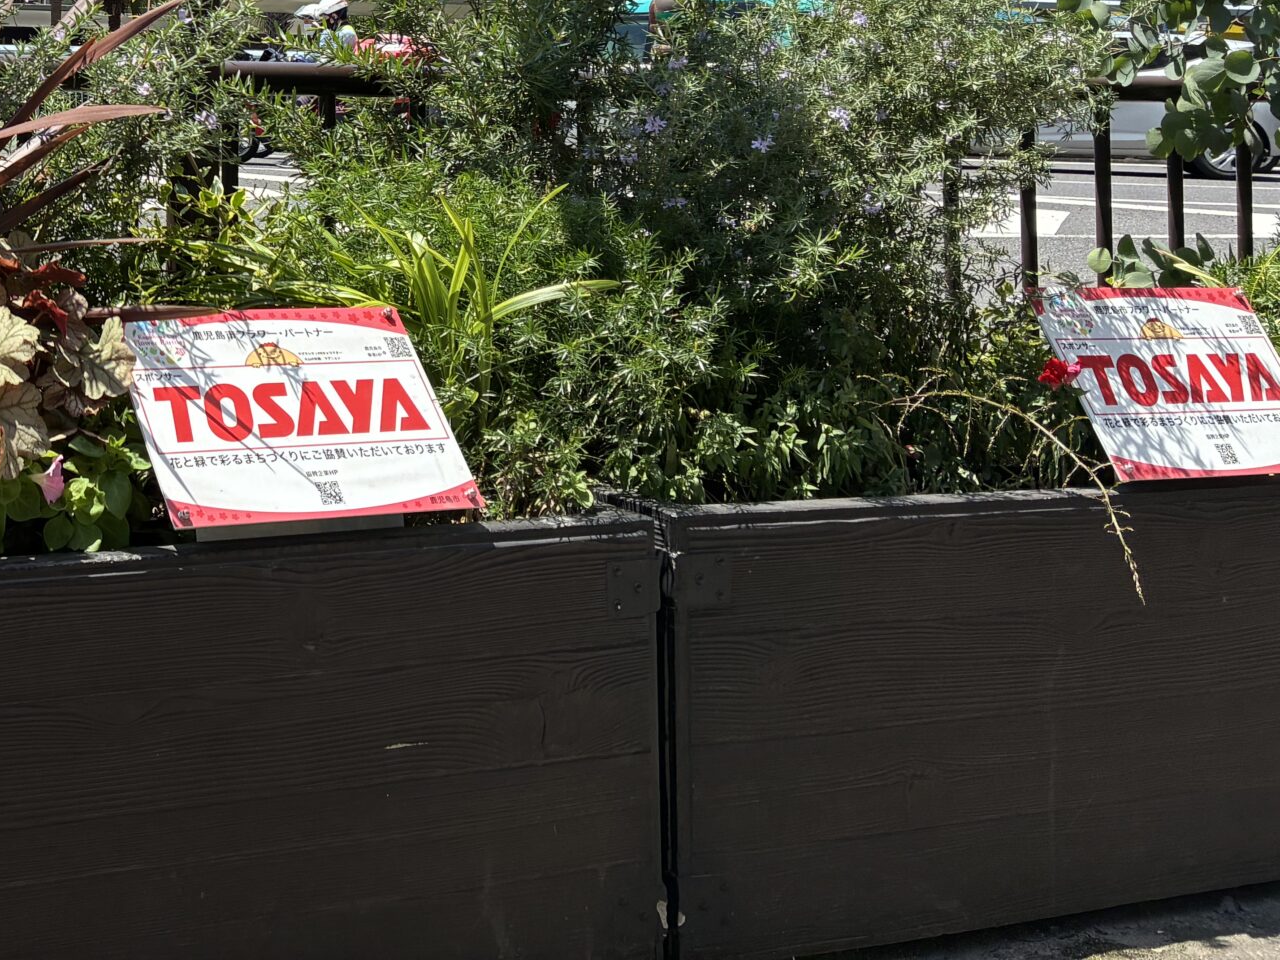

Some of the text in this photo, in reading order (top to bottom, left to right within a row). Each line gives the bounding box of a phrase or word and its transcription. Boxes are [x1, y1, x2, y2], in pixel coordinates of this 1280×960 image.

[135, 371, 183, 383] スポンサー
[1077, 352, 1280, 407] TOSAYA
[153, 377, 431, 443] TOSAYA
